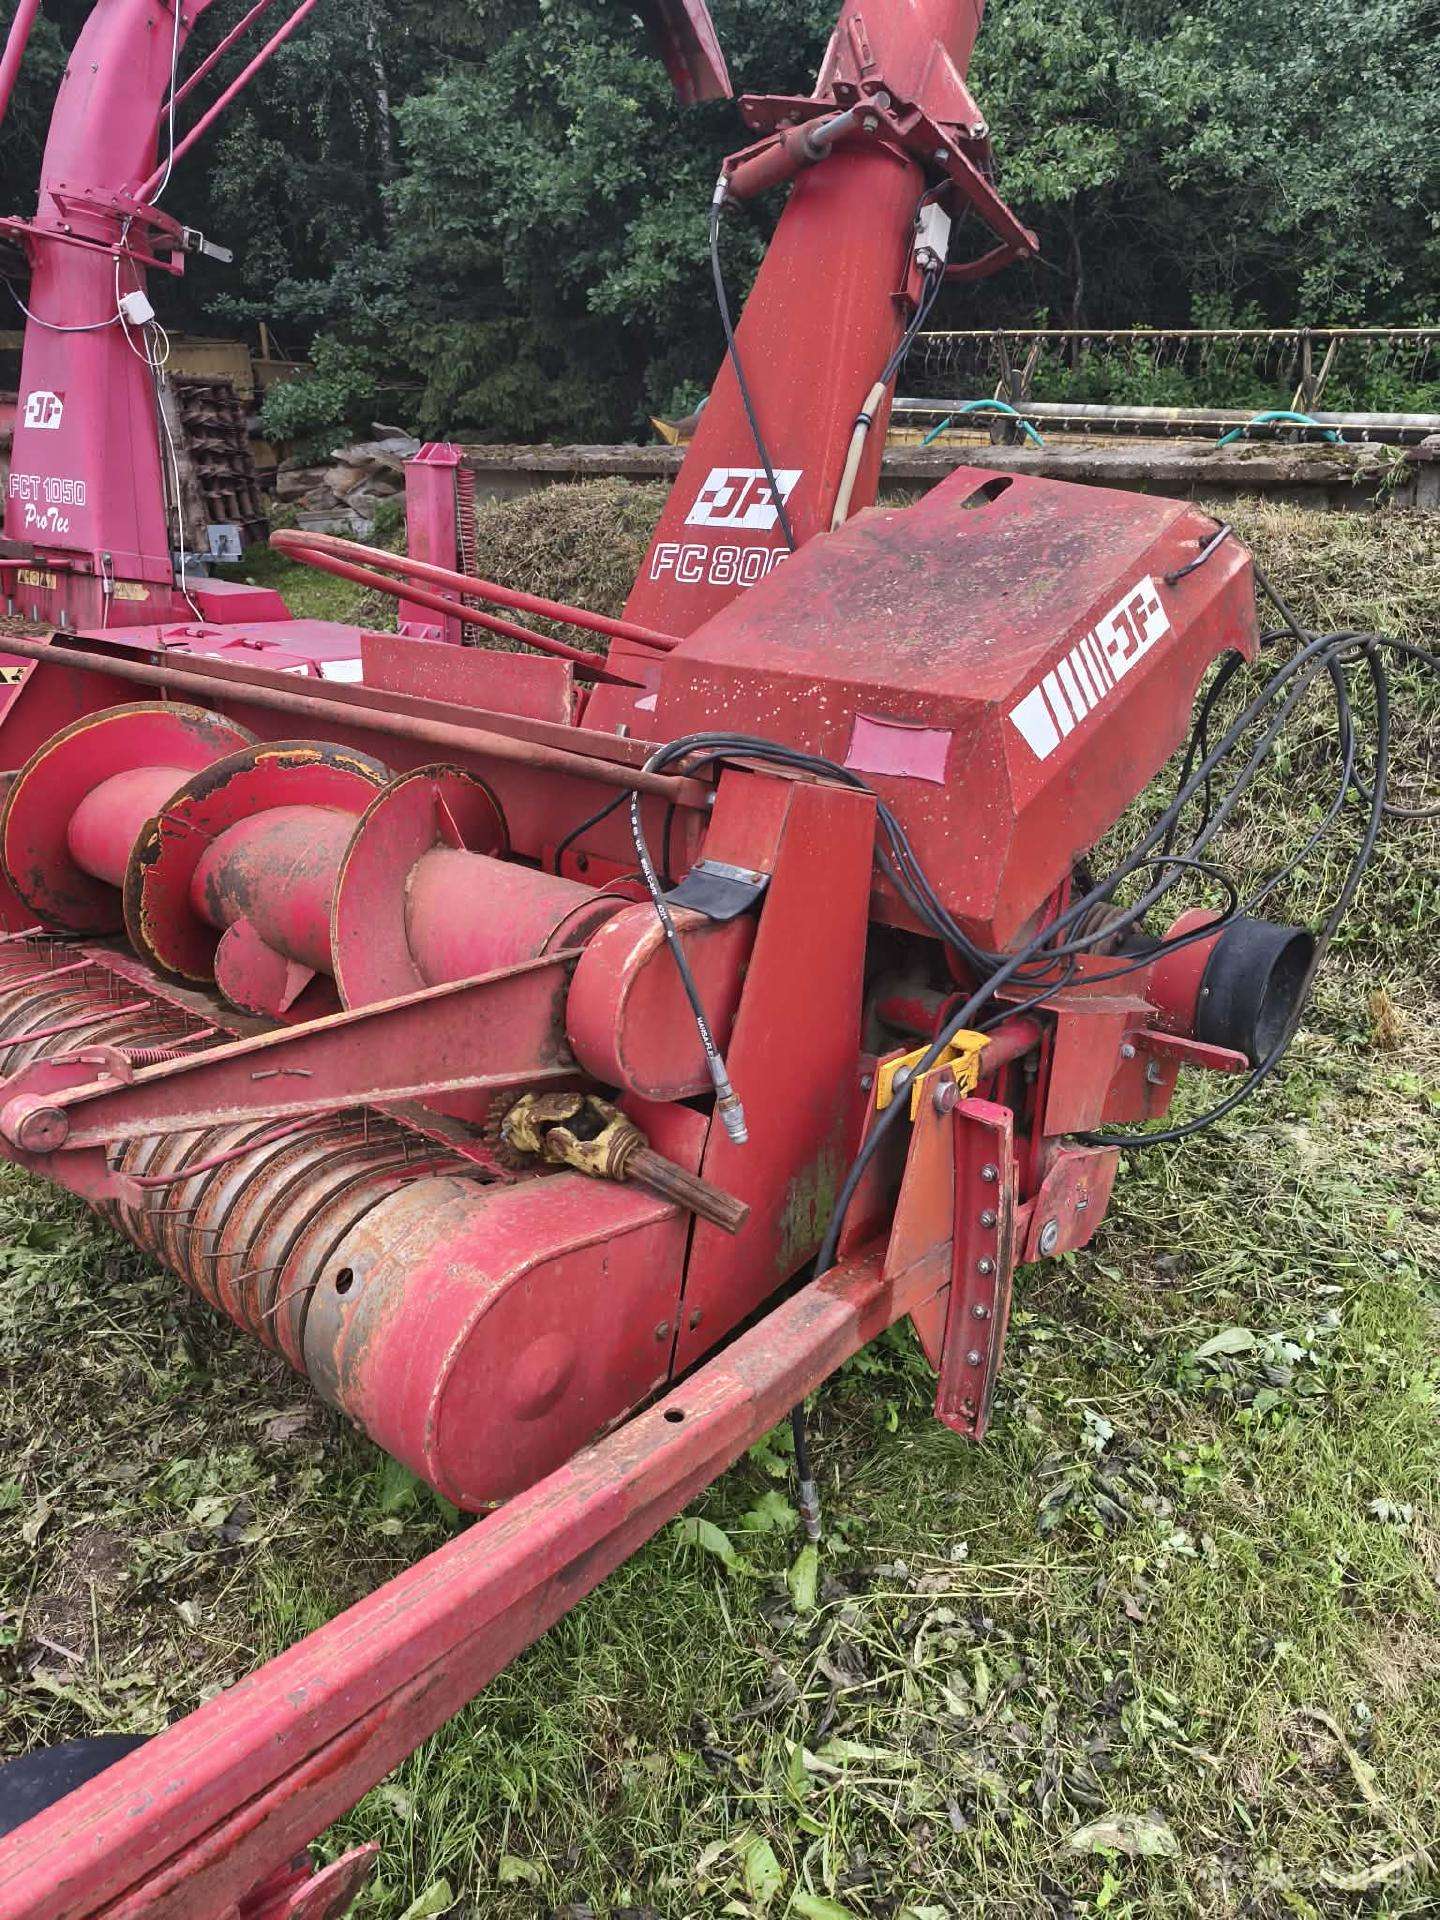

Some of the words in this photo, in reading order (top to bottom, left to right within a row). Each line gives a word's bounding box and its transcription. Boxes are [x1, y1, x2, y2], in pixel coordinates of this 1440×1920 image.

[9, 473, 41, 501] FCT
[42, 477, 86, 506] 1050
[650, 543, 708, 583] FC
